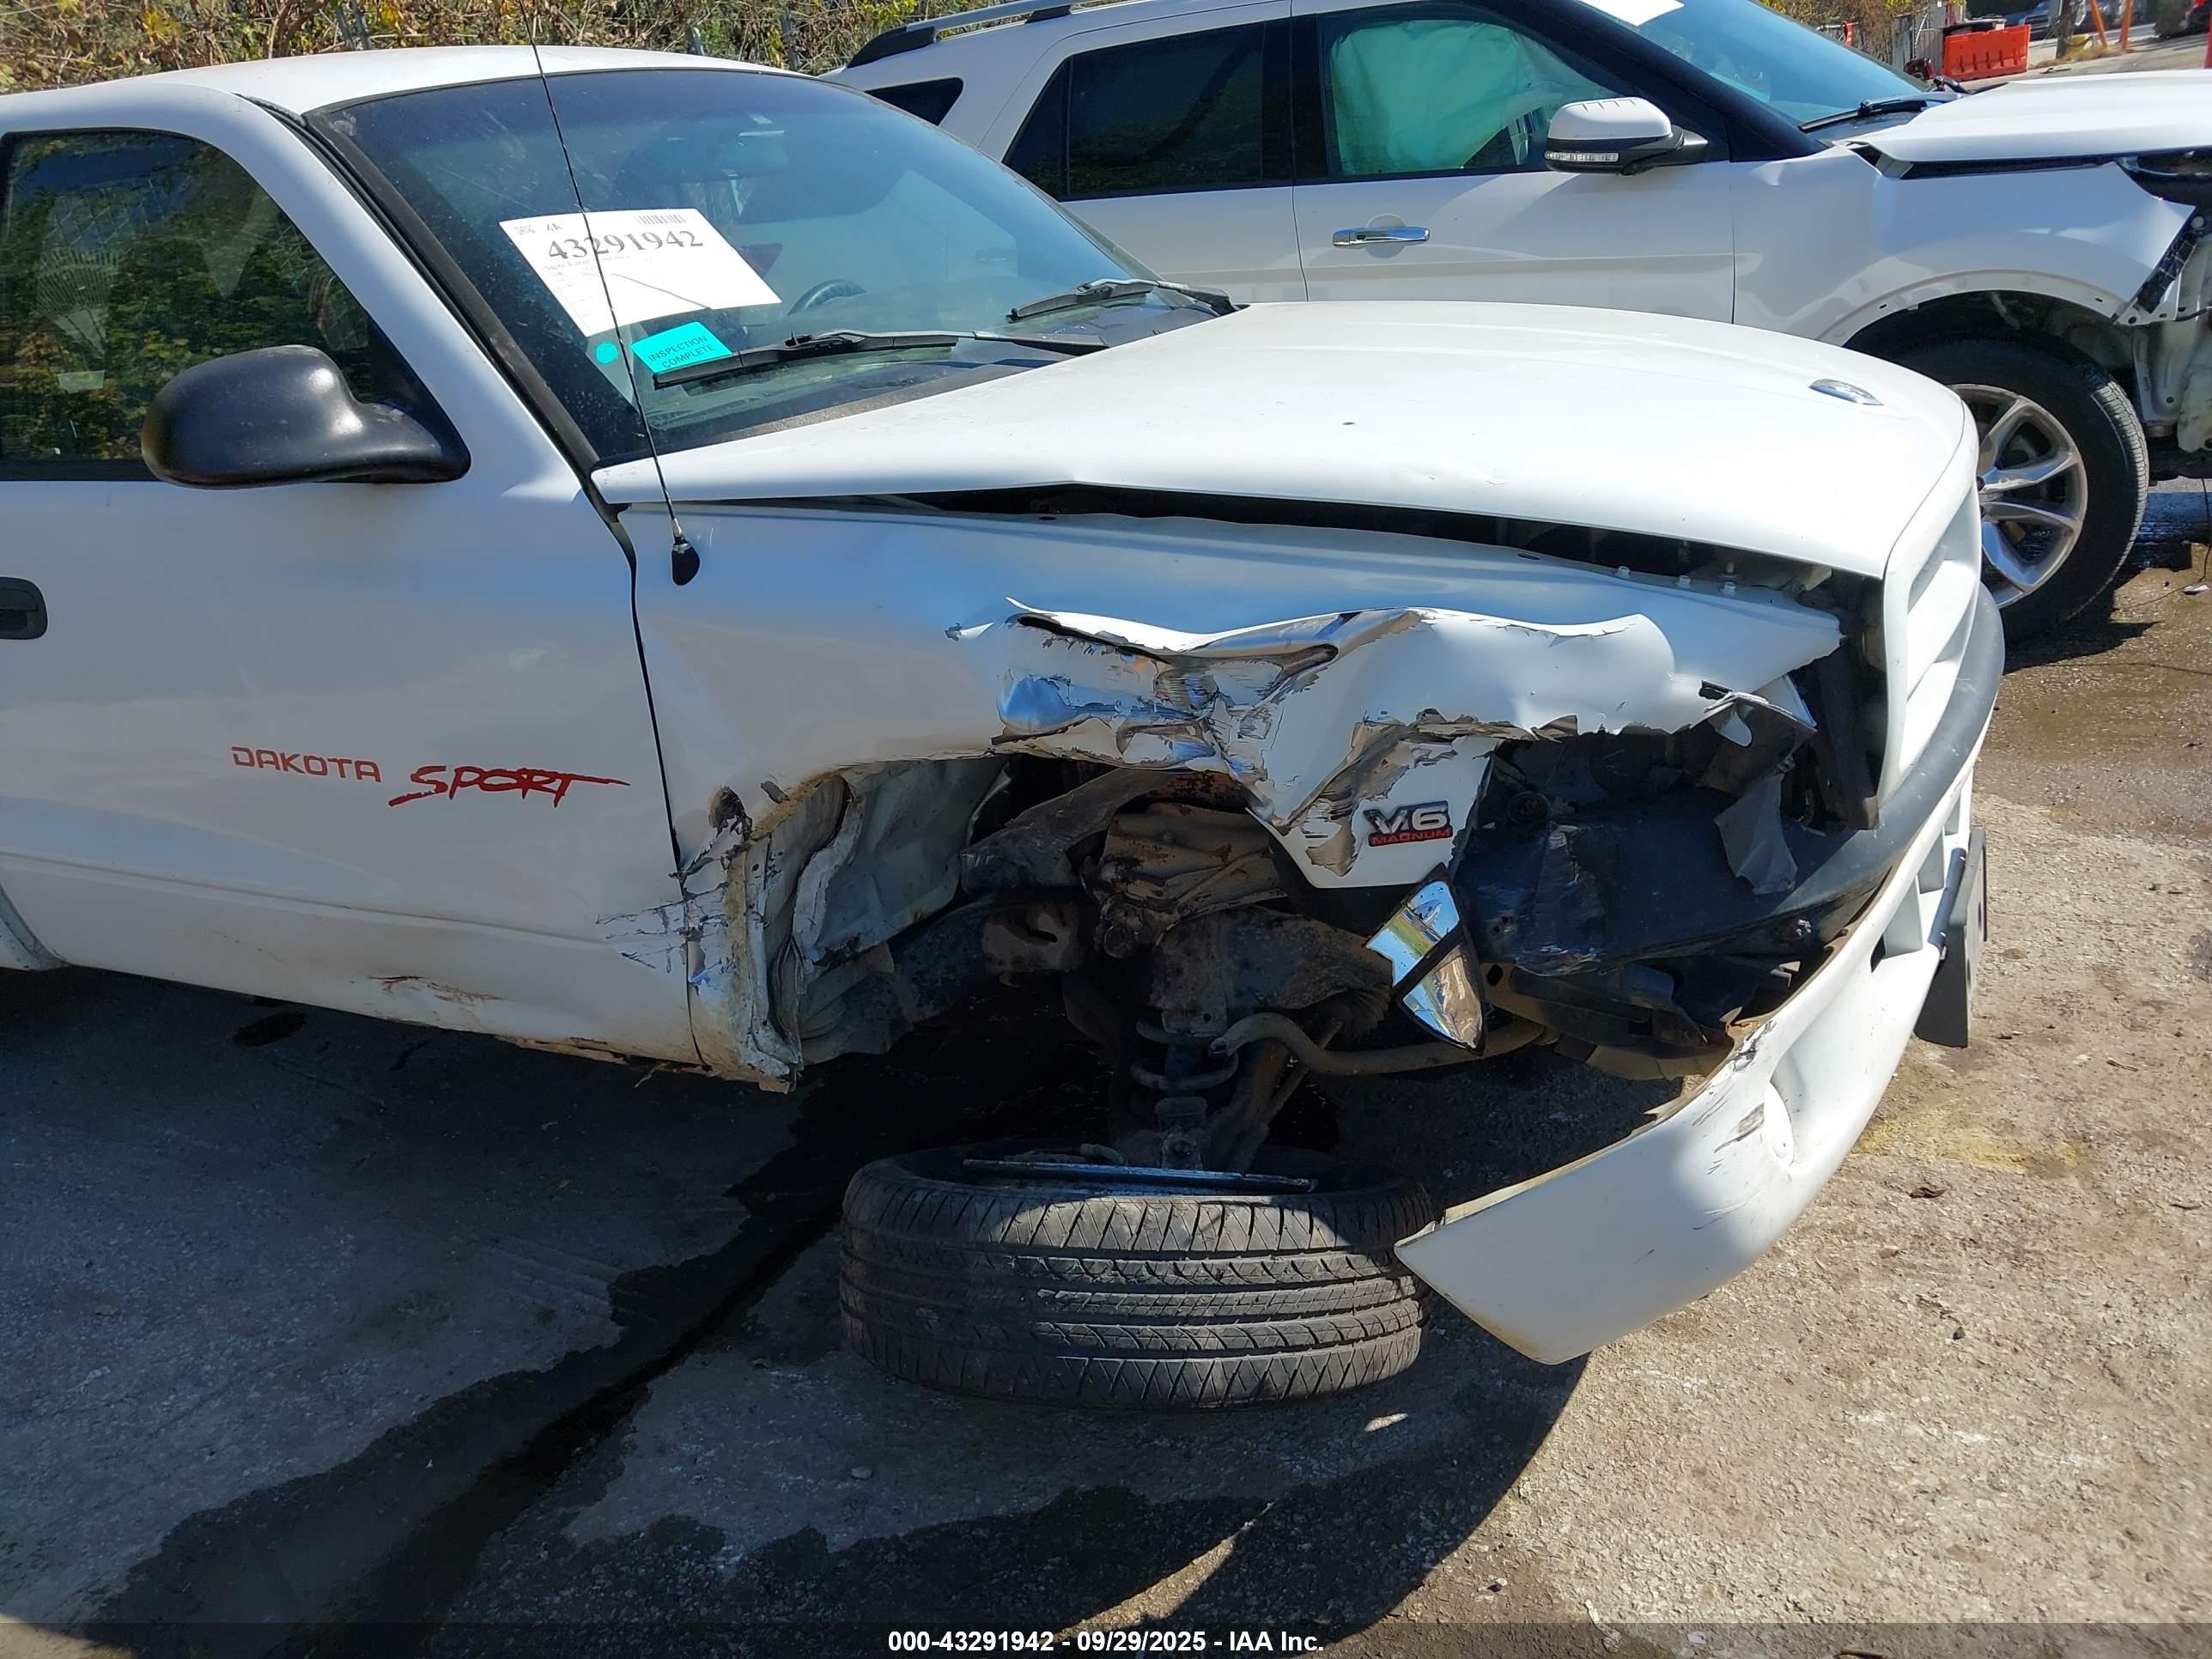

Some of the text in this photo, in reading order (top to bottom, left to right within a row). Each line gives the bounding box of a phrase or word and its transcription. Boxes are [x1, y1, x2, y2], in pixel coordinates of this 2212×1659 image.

[548, 230, 704, 259] 43291942
[647, 335, 708, 362] INSPECTION
[661, 343, 716, 368] COMPLETE
[231, 746, 631, 808] DAKOTA SPORT
[1364, 802, 1449, 834] V6
[1371, 829, 1451, 845] MAGNUM
